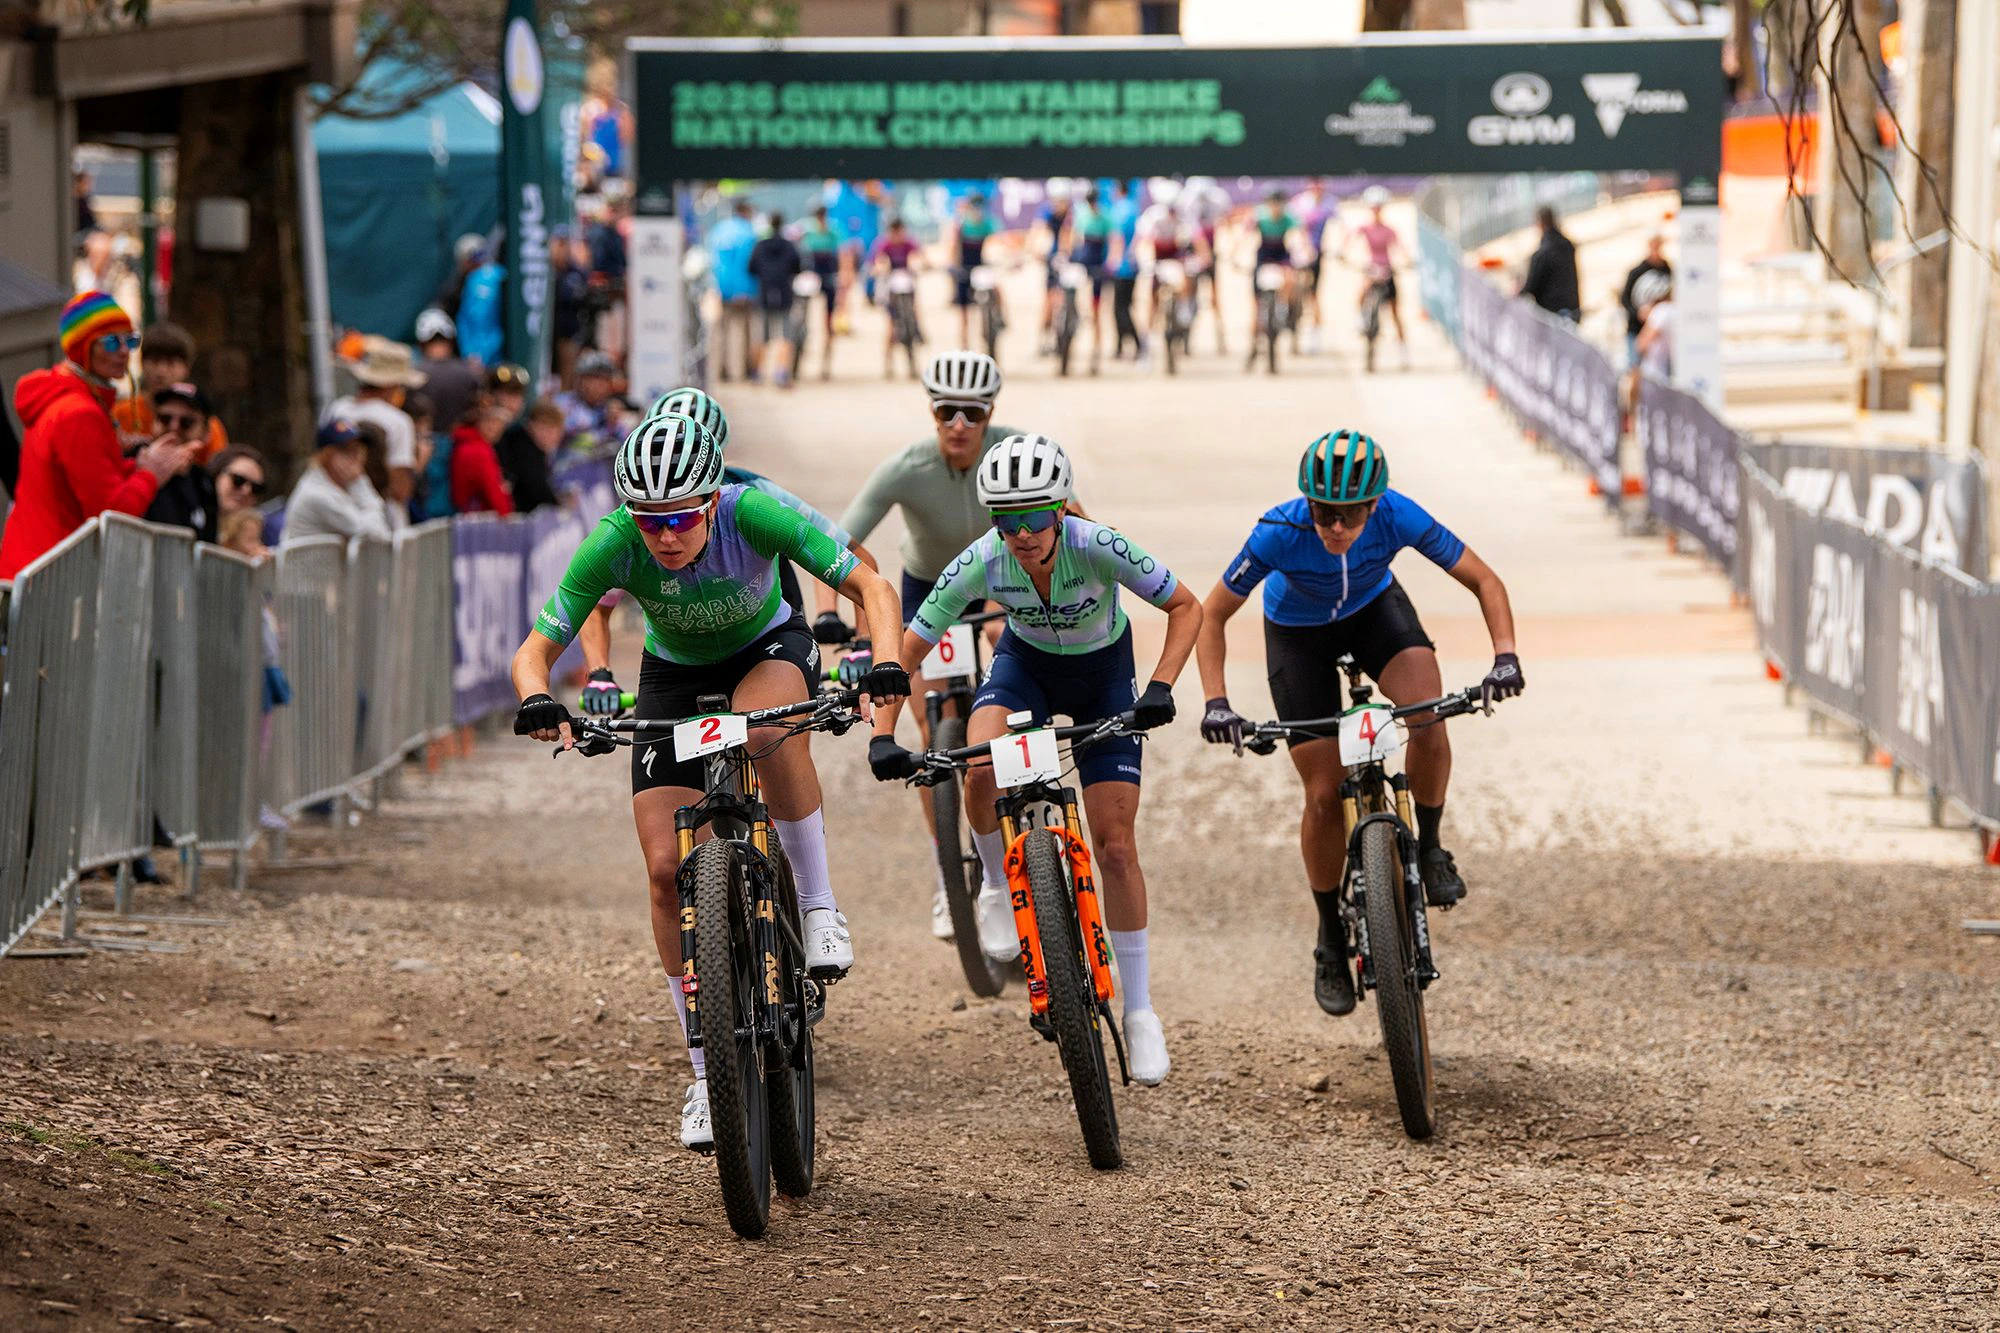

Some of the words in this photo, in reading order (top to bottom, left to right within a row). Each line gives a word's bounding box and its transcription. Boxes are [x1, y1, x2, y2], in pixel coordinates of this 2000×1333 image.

[780, 81, 889, 112] GWM
[893, 80, 1117, 112] MOUNTAIN
[1121, 79, 1221, 111] BIKE
[672, 116, 886, 148] NATIONAL
[888, 112, 1244, 148] CHAMPIONSHIPS
[1468, 114, 1575, 146] GWM
[993, 585, 1029, 593] SHIMANO
[1063, 576, 1085, 591] HIRU
[939, 632, 954, 663] 6
[700, 717, 721, 745] 2
[1359, 712, 1377, 745] 4
[1015, 735, 1031, 768] 1
